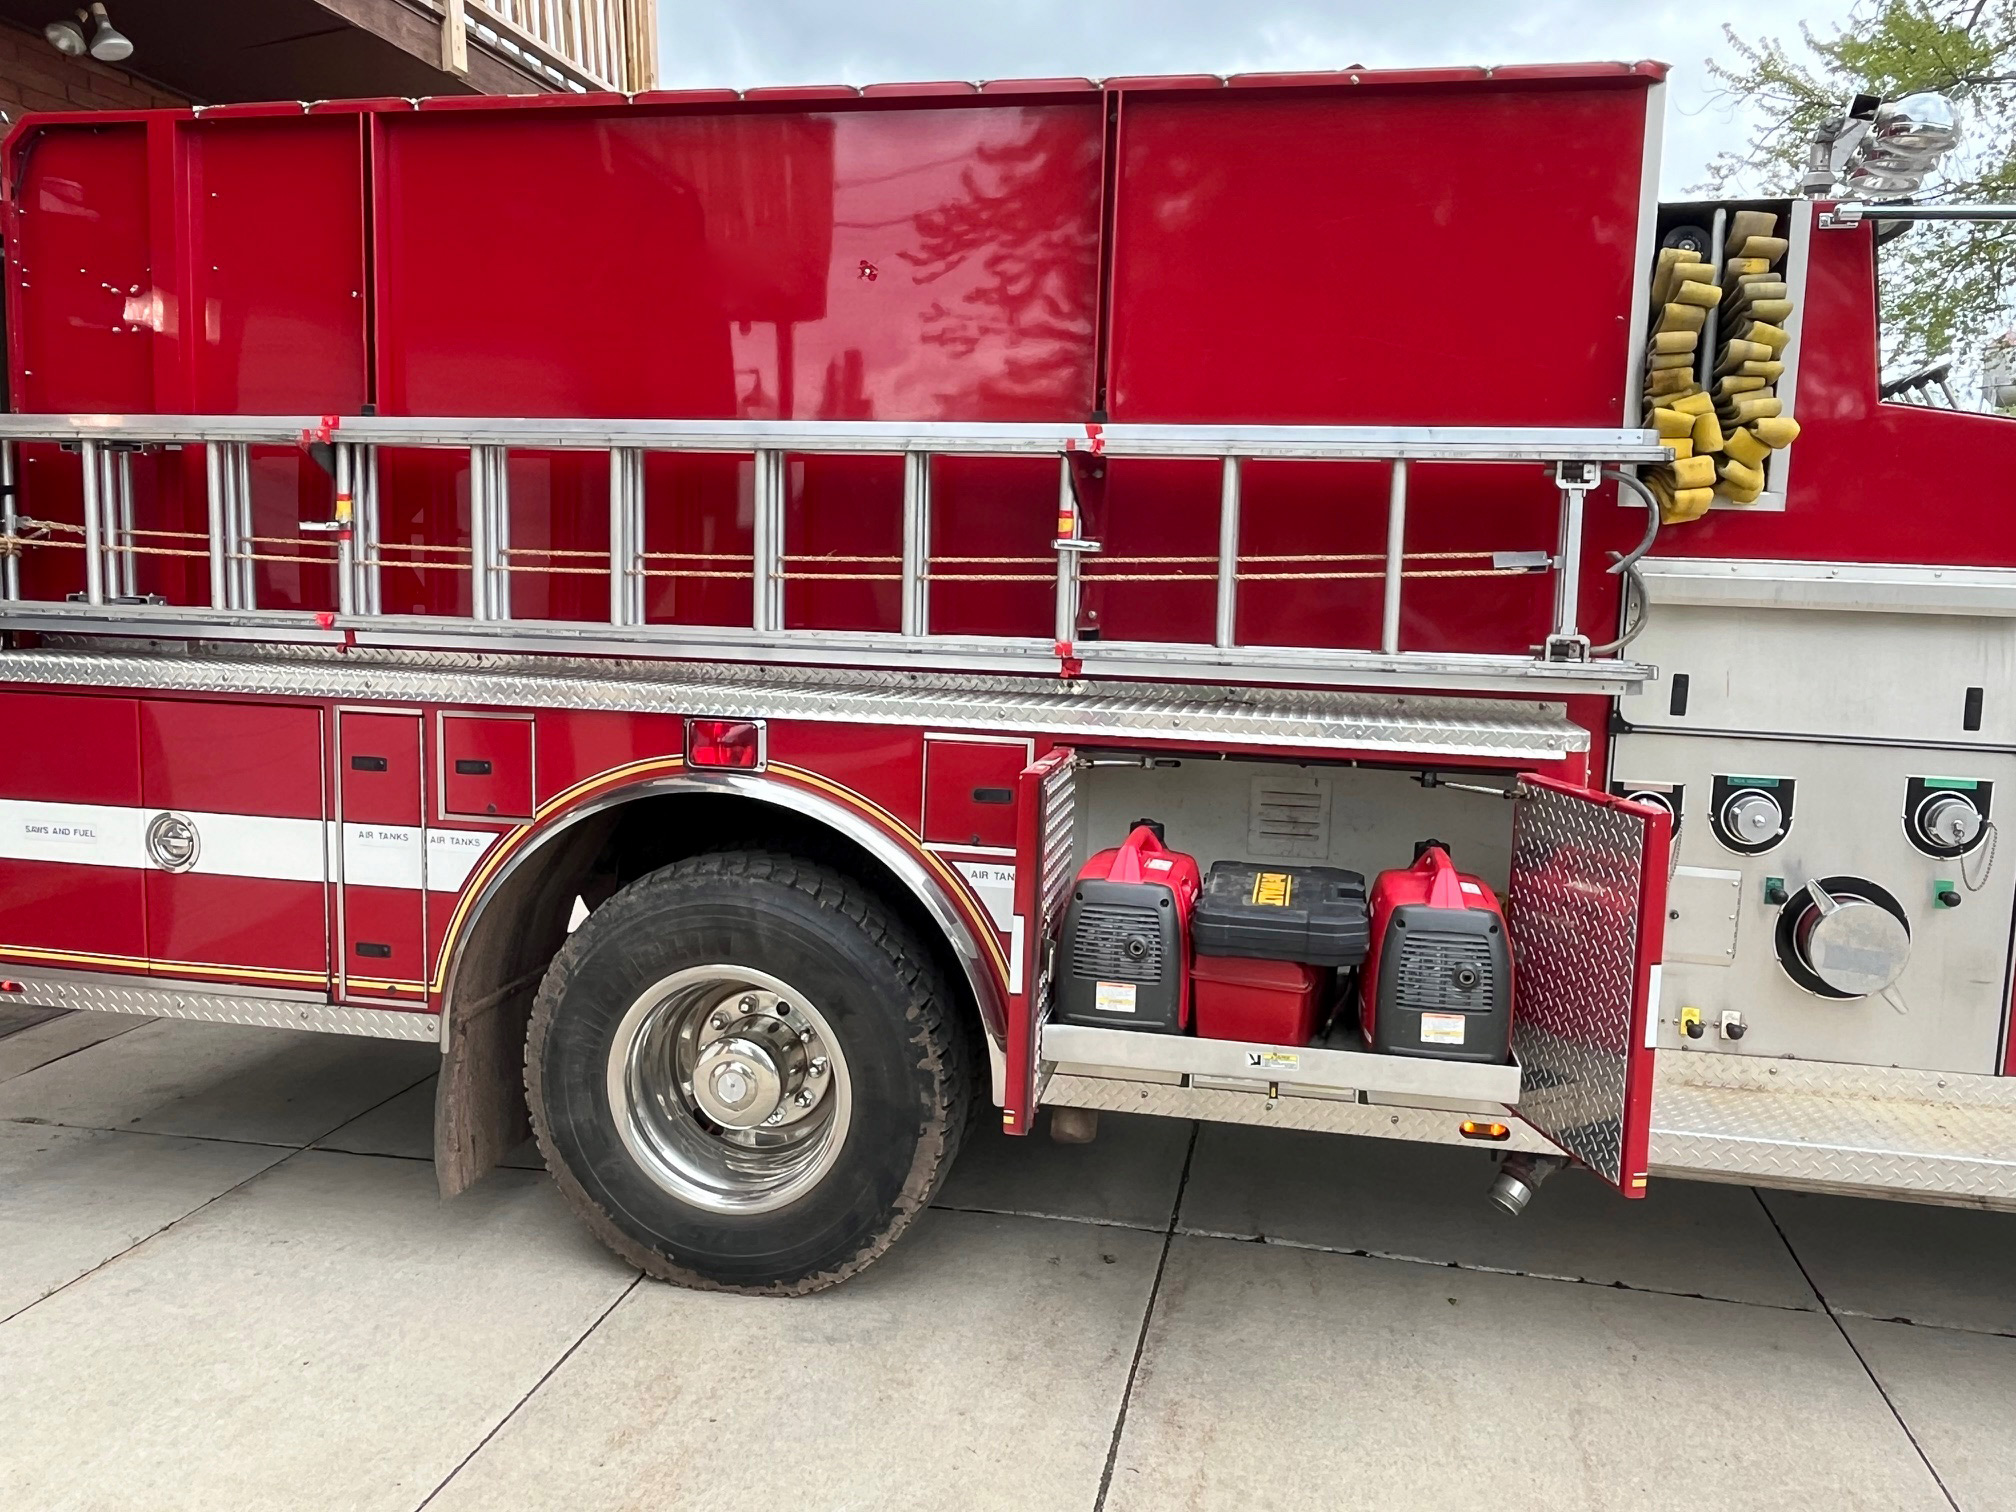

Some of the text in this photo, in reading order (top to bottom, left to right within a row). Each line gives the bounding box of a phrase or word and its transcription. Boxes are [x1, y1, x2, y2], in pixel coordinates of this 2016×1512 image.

[25, 825, 96, 838] SAWS AND FUEL
[358, 830, 409, 842] AIR TANKS
[430, 836, 481, 847] AIR TANKS
[970, 870, 1015, 881] AIR TAN
